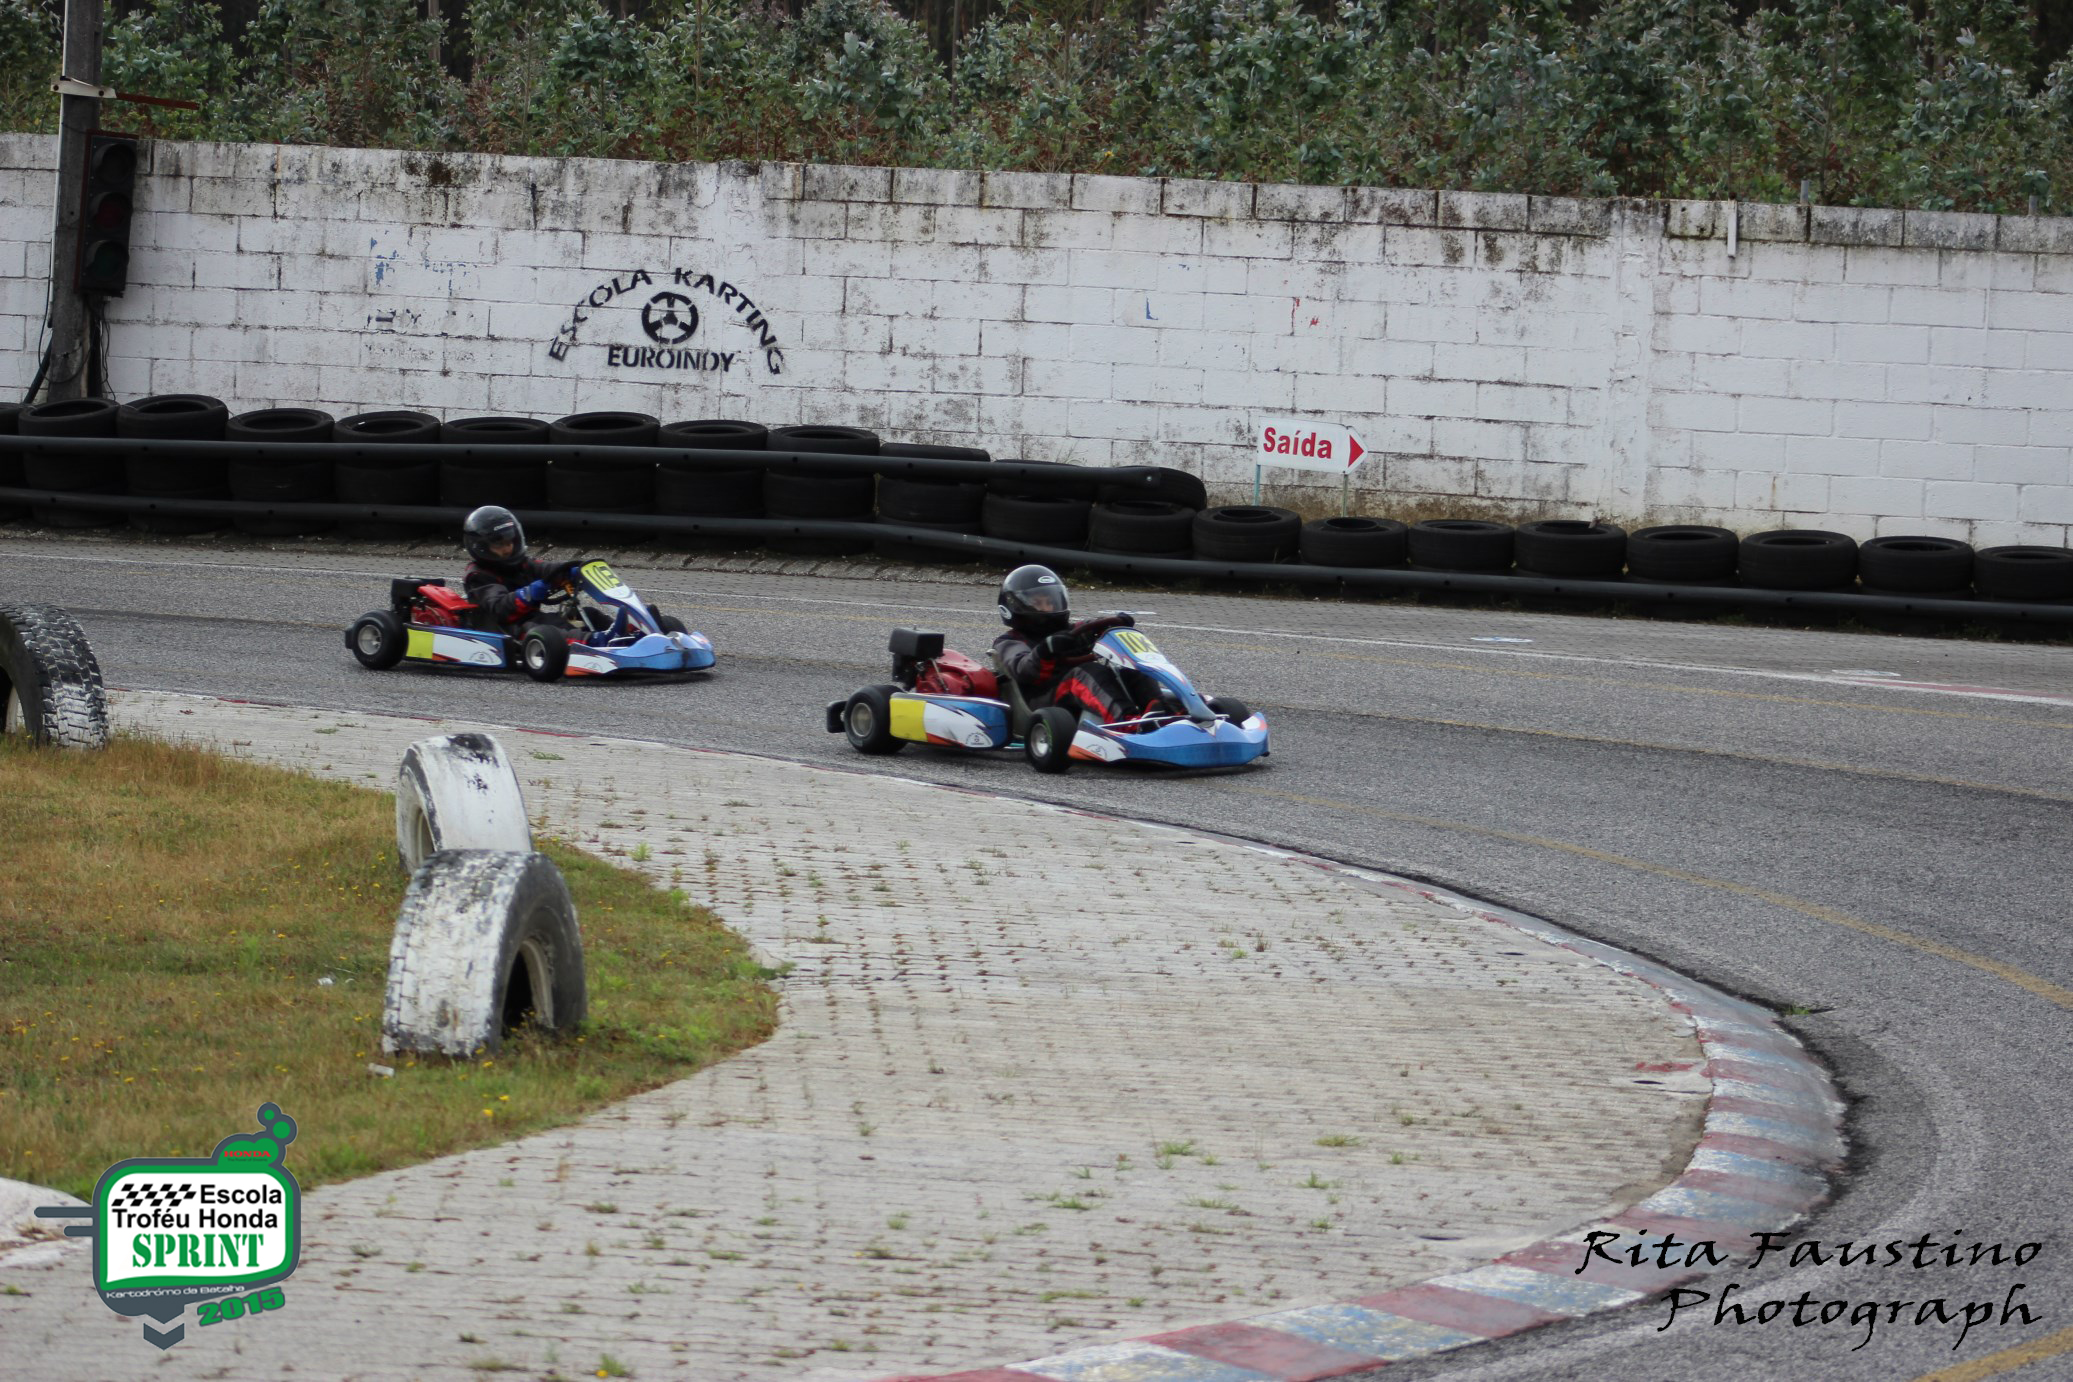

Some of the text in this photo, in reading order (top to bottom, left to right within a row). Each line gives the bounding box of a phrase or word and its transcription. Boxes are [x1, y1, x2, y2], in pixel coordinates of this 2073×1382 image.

[674, 267, 784, 375] KARTING
[607, 345, 735, 372] EUROINDY
[1263, 426, 1332, 459] Saída
